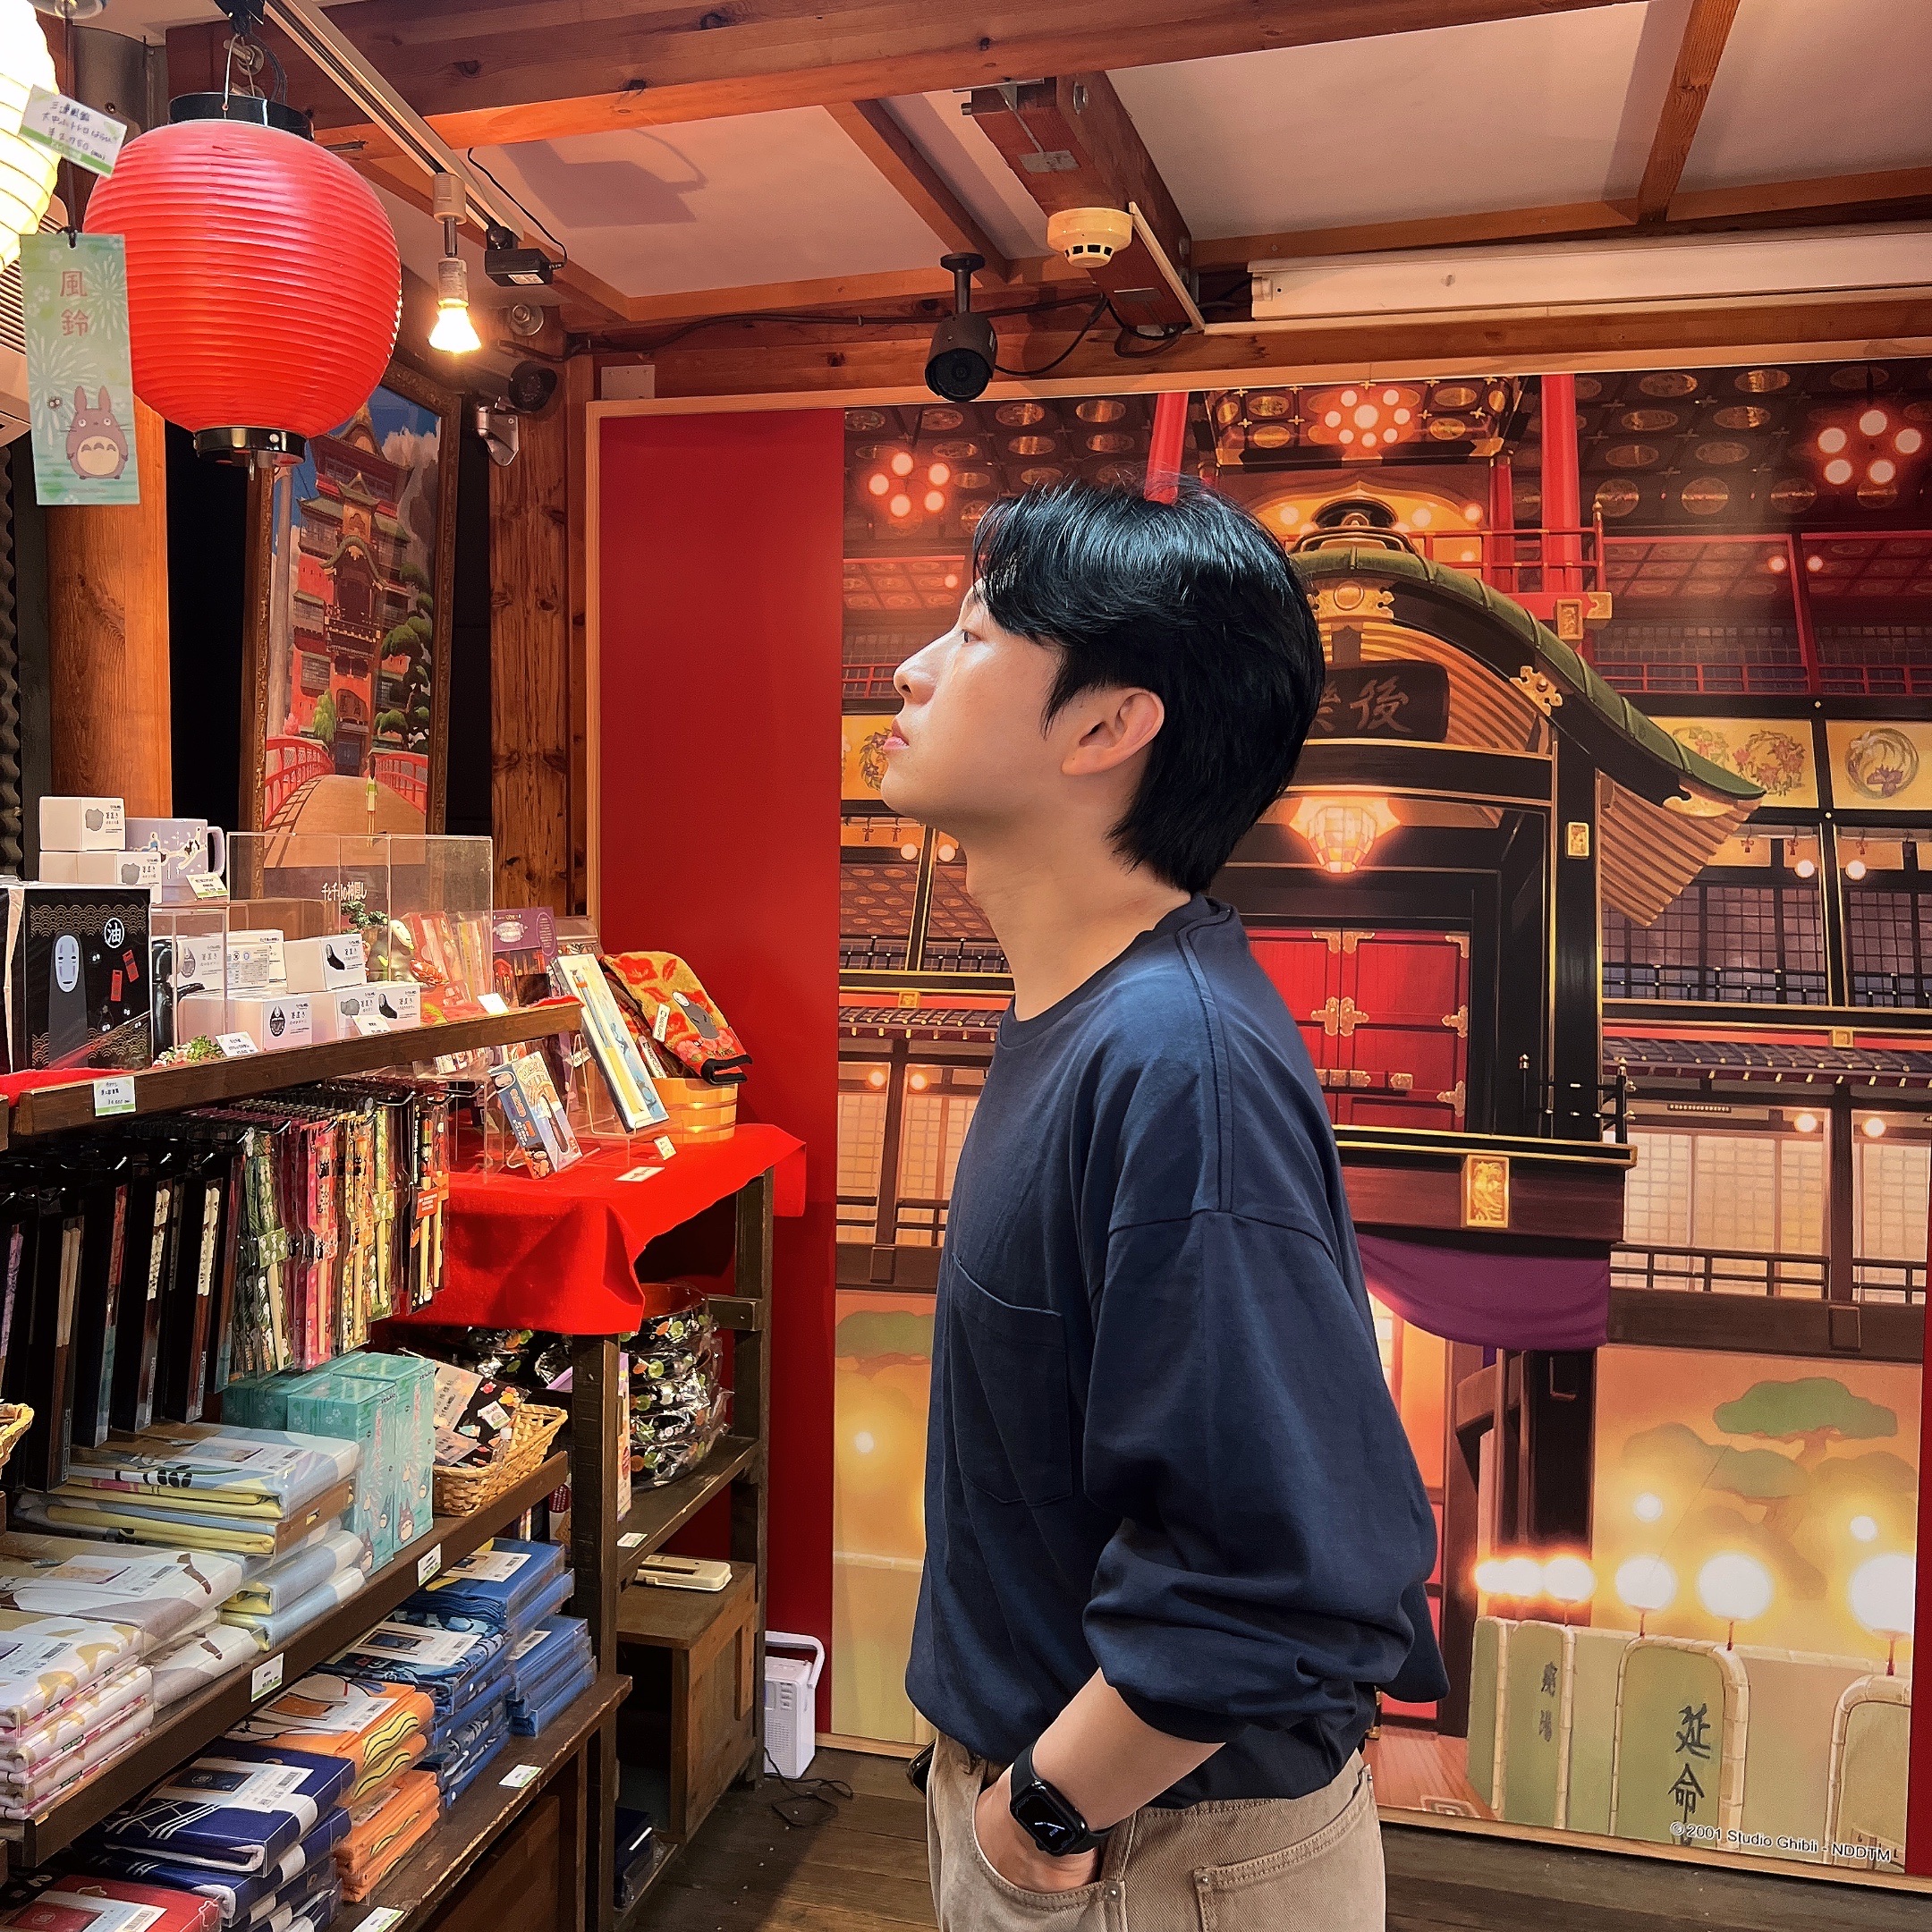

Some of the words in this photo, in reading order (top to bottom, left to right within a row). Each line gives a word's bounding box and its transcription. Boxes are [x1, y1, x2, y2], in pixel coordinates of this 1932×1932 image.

[59, 270, 89, 337] 風鈴
[1686, 1824, 1722, 1840] 2001
[1727, 1829, 1773, 1848] Studio
[1776, 1835, 1819, 1853] Ghibli
[1832, 1843, 1892, 1863] NDDTM
